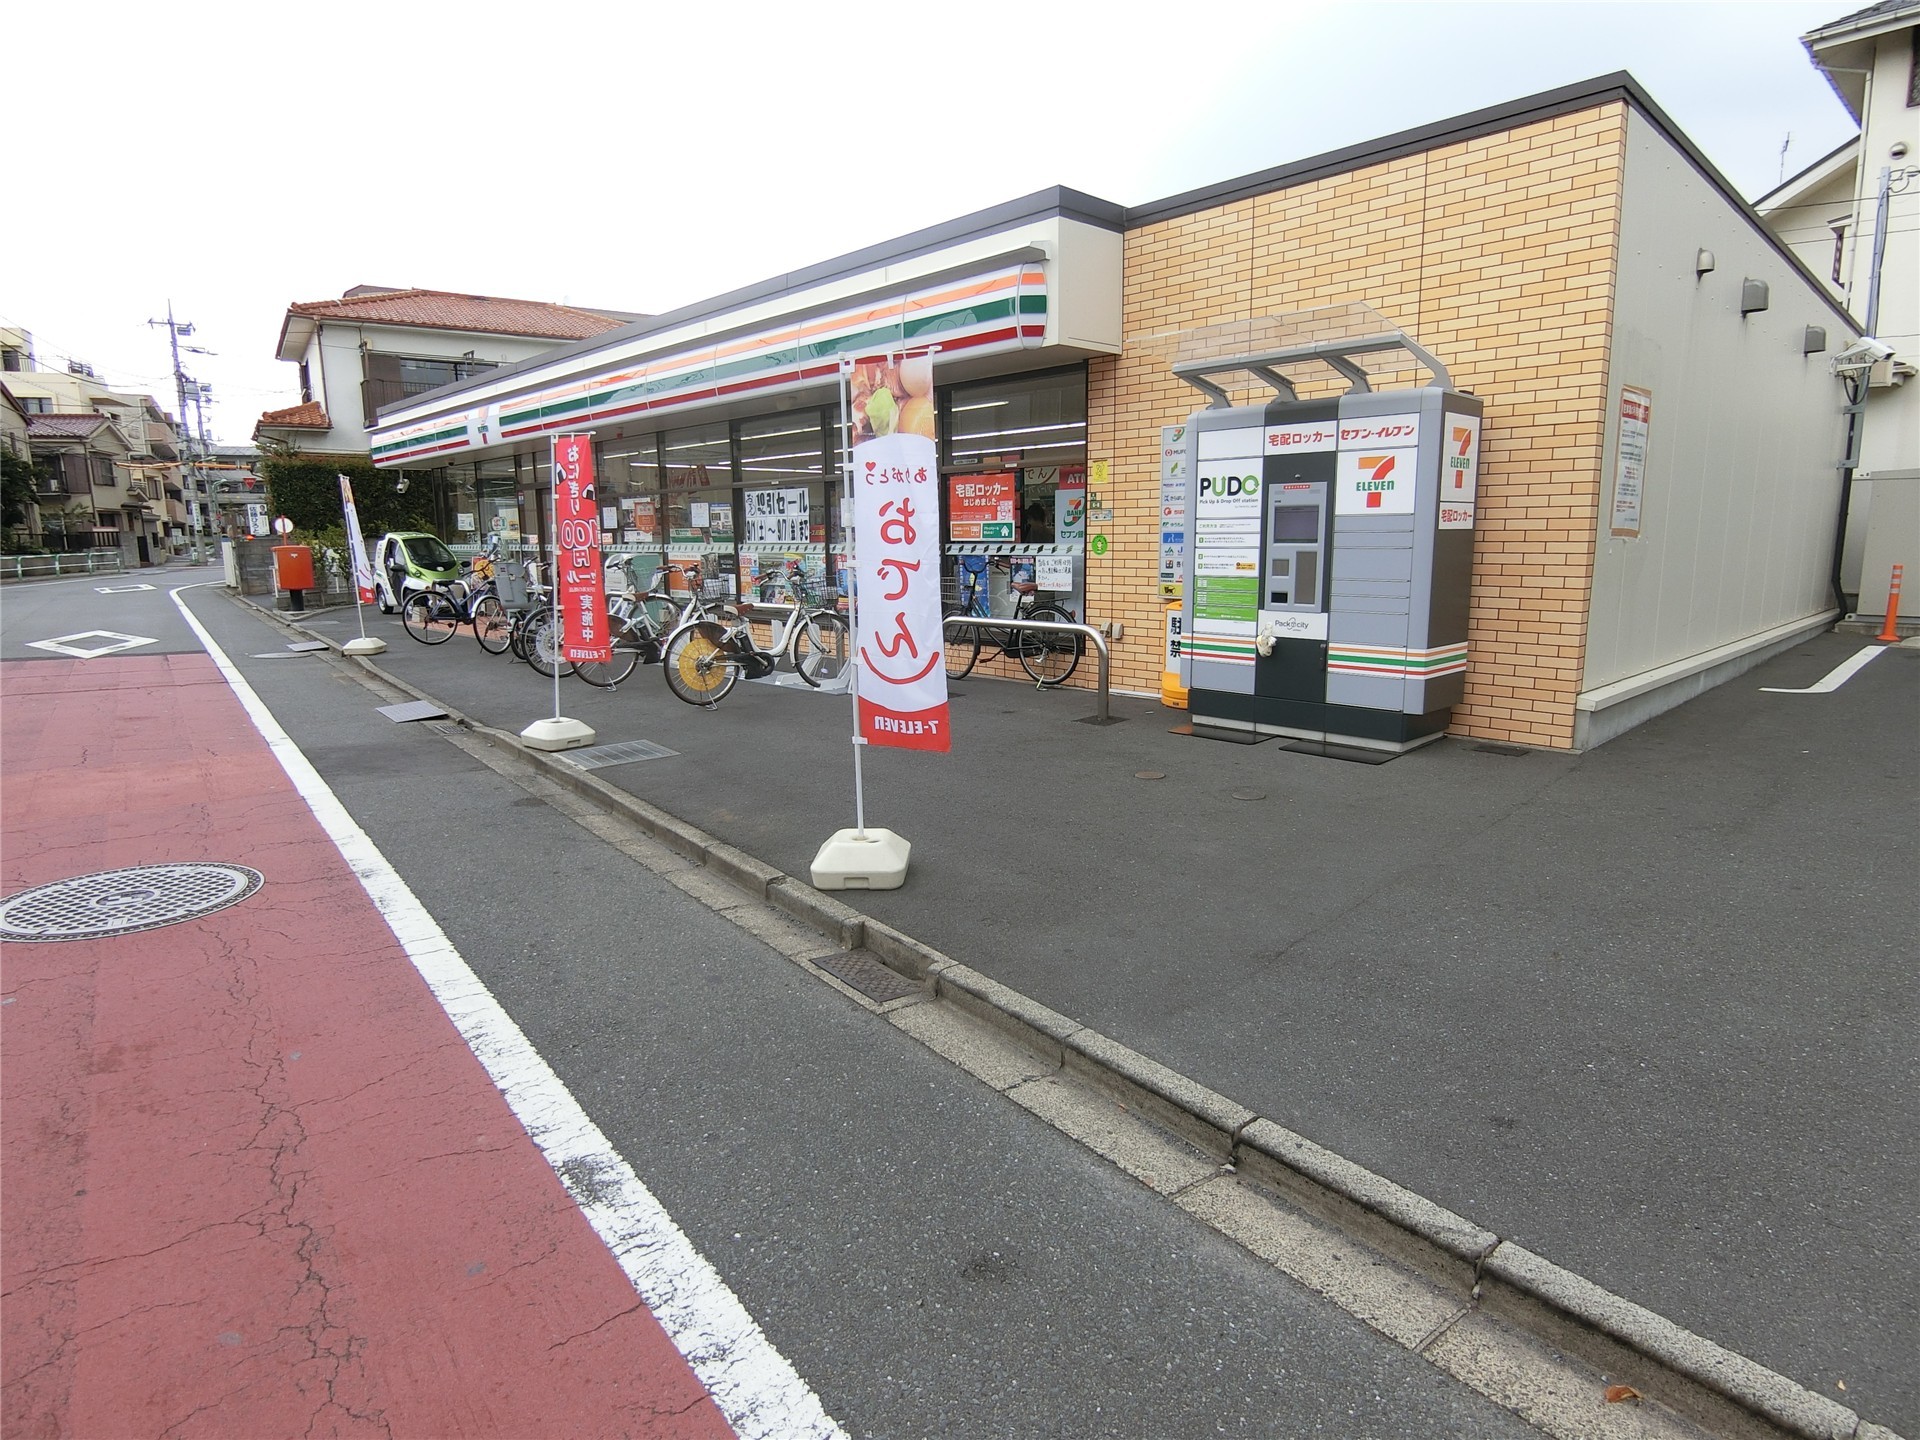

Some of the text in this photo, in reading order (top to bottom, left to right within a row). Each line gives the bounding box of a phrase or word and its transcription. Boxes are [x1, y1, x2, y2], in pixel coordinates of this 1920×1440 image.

[1268, 425, 1415, 447] 宅配ロッカー セブン-イレブン
[1450, 456, 1470, 469] ELEVEN
[956, 483, 1009, 497] 宅配ロッカー
[1200, 475, 1260, 497] PUDO
[1356, 481, 1395, 491] ELEVEN
[1441, 509, 1473, 523] 宅配ロッカー
